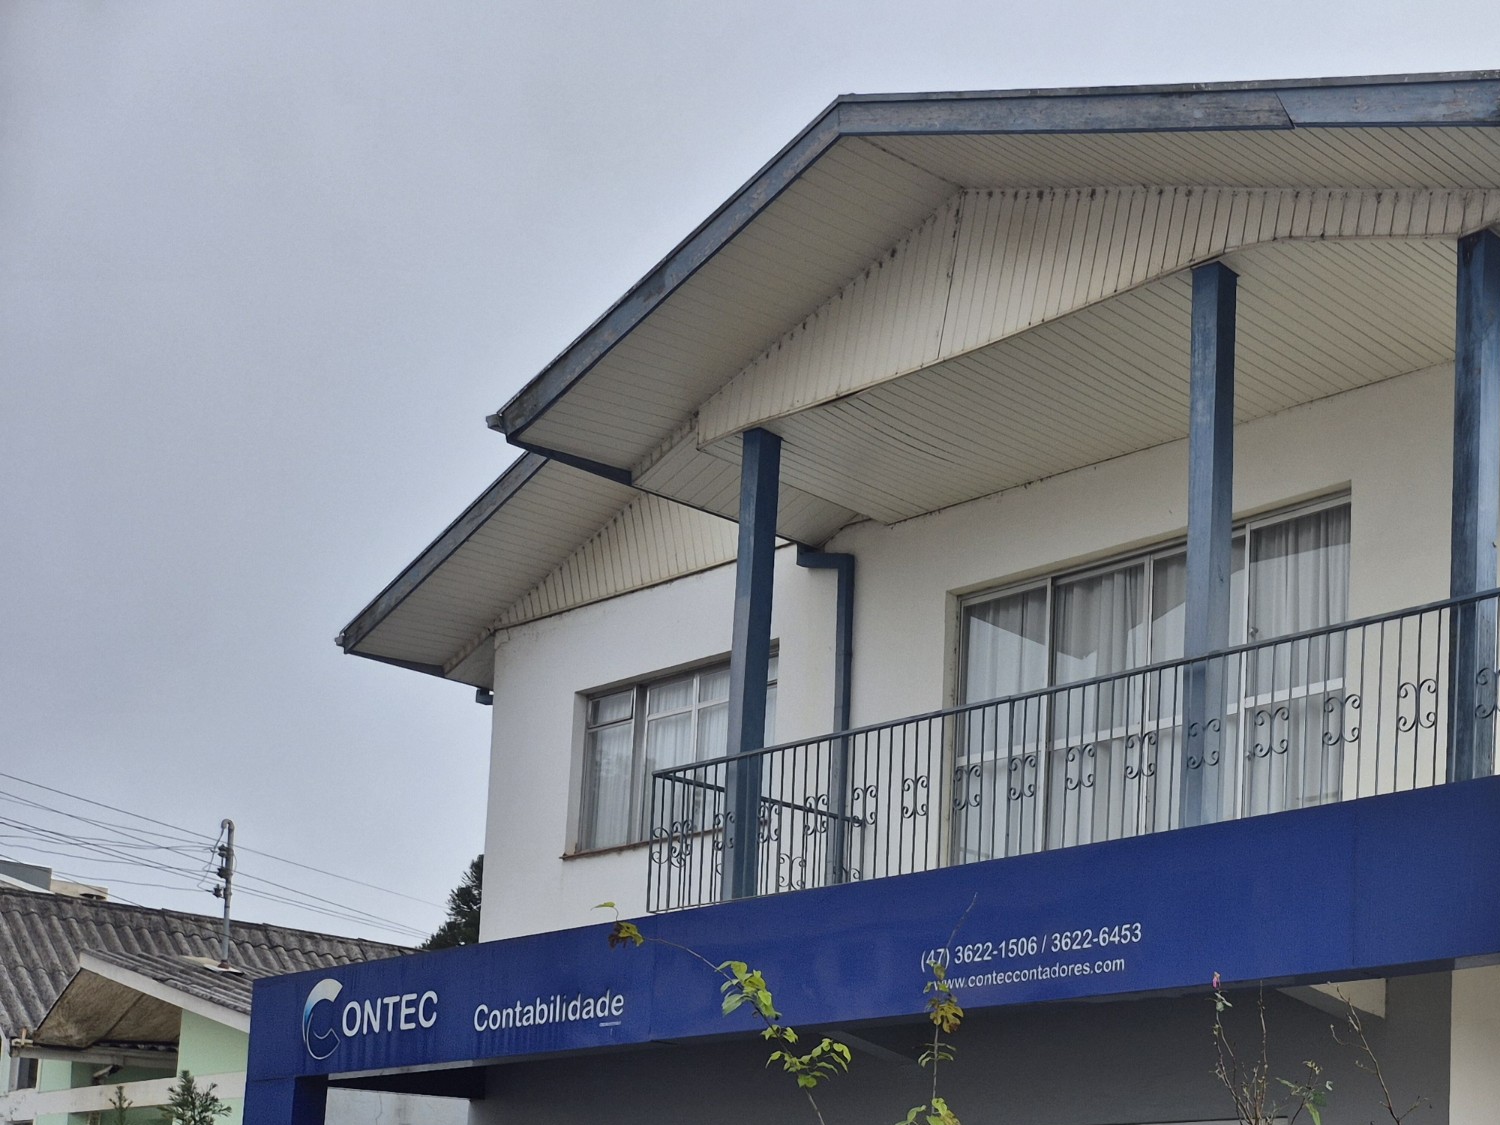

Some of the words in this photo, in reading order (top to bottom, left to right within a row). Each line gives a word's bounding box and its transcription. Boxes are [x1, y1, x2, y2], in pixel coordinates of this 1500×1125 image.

[921, 948, 950, 973] (47)
[954, 936, 1038, 964] 3622-1506
[1051, 922, 1142, 953] 3622-6453
[474, 989, 625, 1031] Contabilidade
